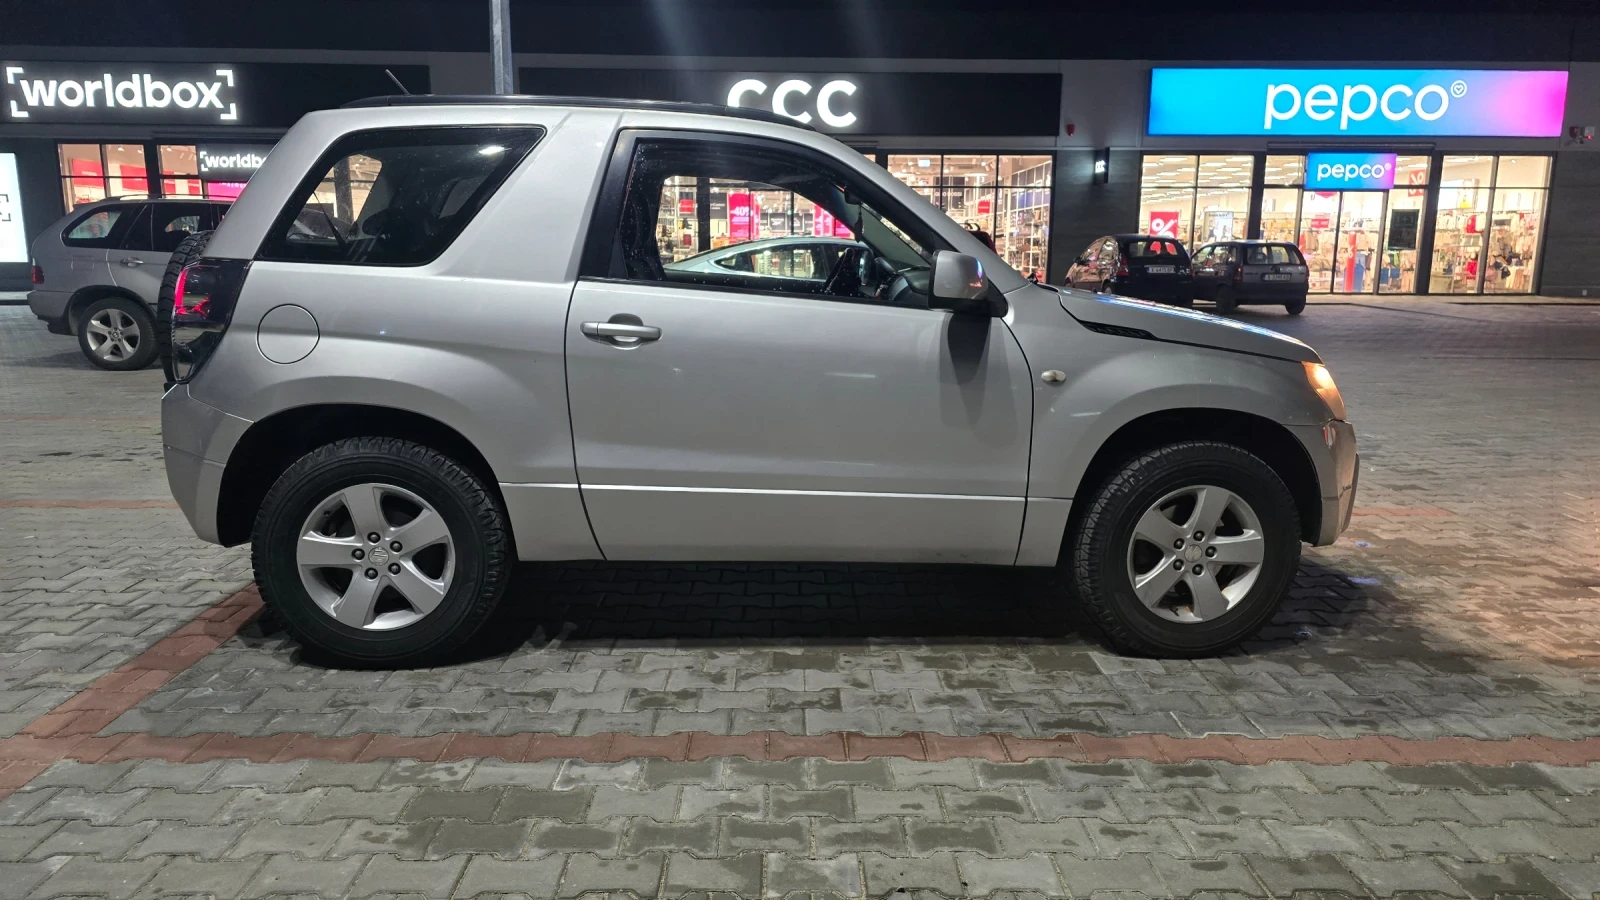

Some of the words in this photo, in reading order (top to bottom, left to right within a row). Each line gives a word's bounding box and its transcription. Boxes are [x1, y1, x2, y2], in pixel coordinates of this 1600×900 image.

[20, 73, 224, 109] worldbox
[727, 79, 858, 128] CCC
[1264, 84, 1449, 130] pepco
[1317, 163, 1385, 181] pepco
